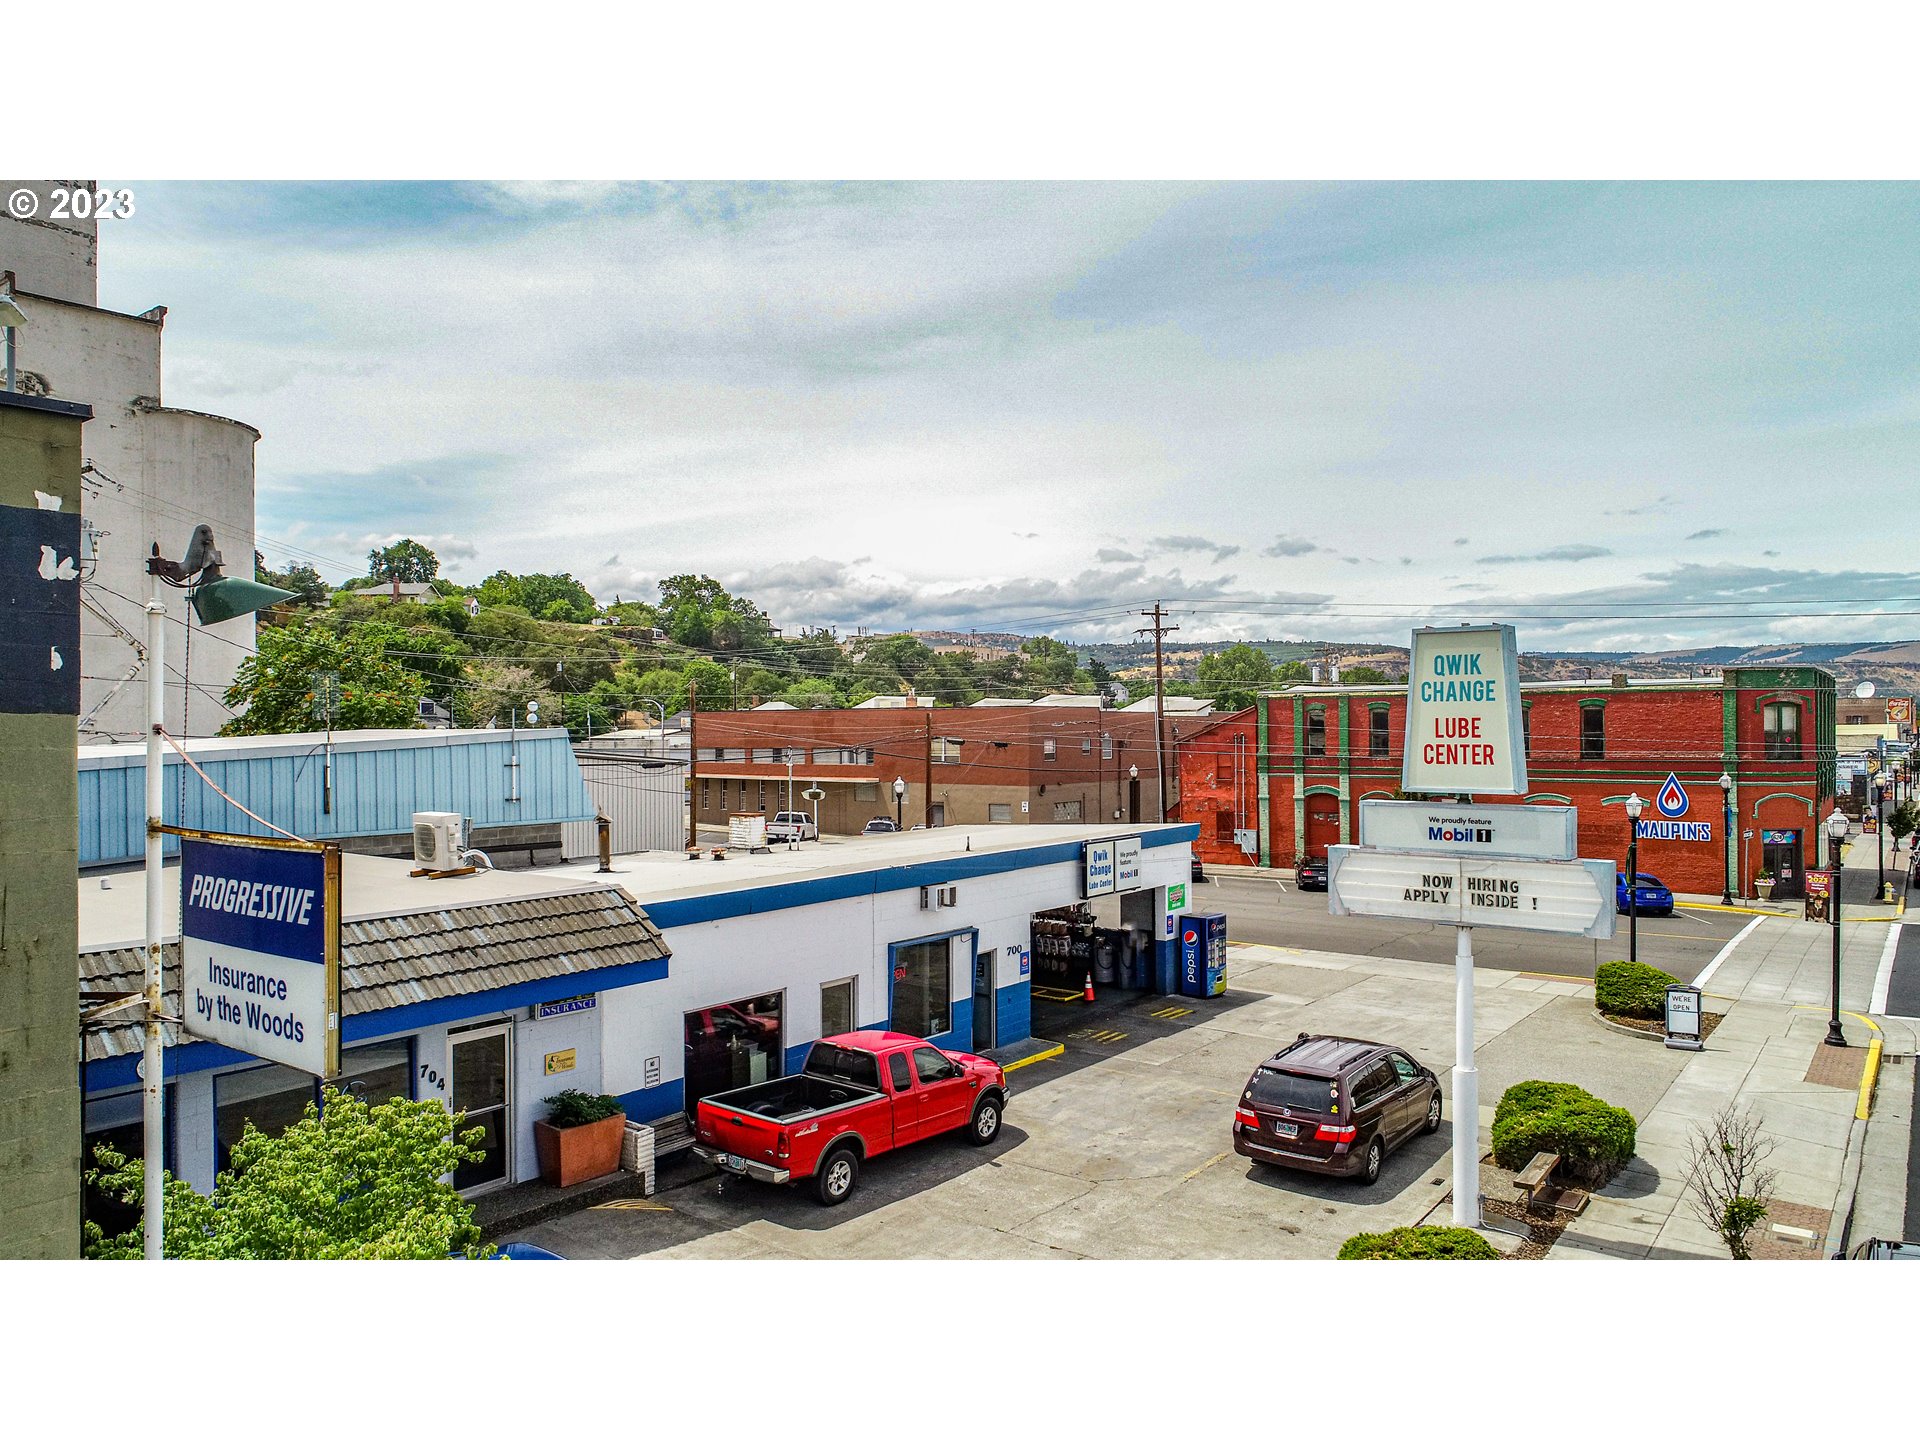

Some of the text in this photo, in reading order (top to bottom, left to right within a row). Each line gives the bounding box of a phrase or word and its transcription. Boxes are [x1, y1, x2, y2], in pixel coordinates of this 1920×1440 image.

[1434, 654, 1482, 676] QWIK
[1421, 680, 1496, 702] CHANGE
[1434, 717, 1482, 738] LUBE
[1423, 744, 1494, 766] CENTER
[1441, 817, 1466, 826] proudly
[1468, 818, 1492, 826] feature
[1636, 820, 1712, 841] MAUPIN'S
[1428, 826, 1473, 842] Mobil
[1094, 849, 1108, 864] Qwik
[1126, 850, 1138, 858] proudly
[1090, 864, 1112, 876] Change
[1120, 870, 1134, 880] Mobil
[1088, 879, 1112, 890] Lube Center
[1422, 874, 1519, 894] NOW HIRING
[188, 874, 316, 926] PROGRESSIVE
[1403, 888, 1449, 904] APPLY
[1471, 893, 1519, 909] INSIDE
[1006, 944, 1022, 956] 700
[1186, 949, 1196, 983] pepsi
[208, 957, 287, 1000] Insurance
[196, 988, 304, 1043] by the Woods
[541, 998, 595, 1016] INSURANCE
[420, 1064, 445, 1090] 704
